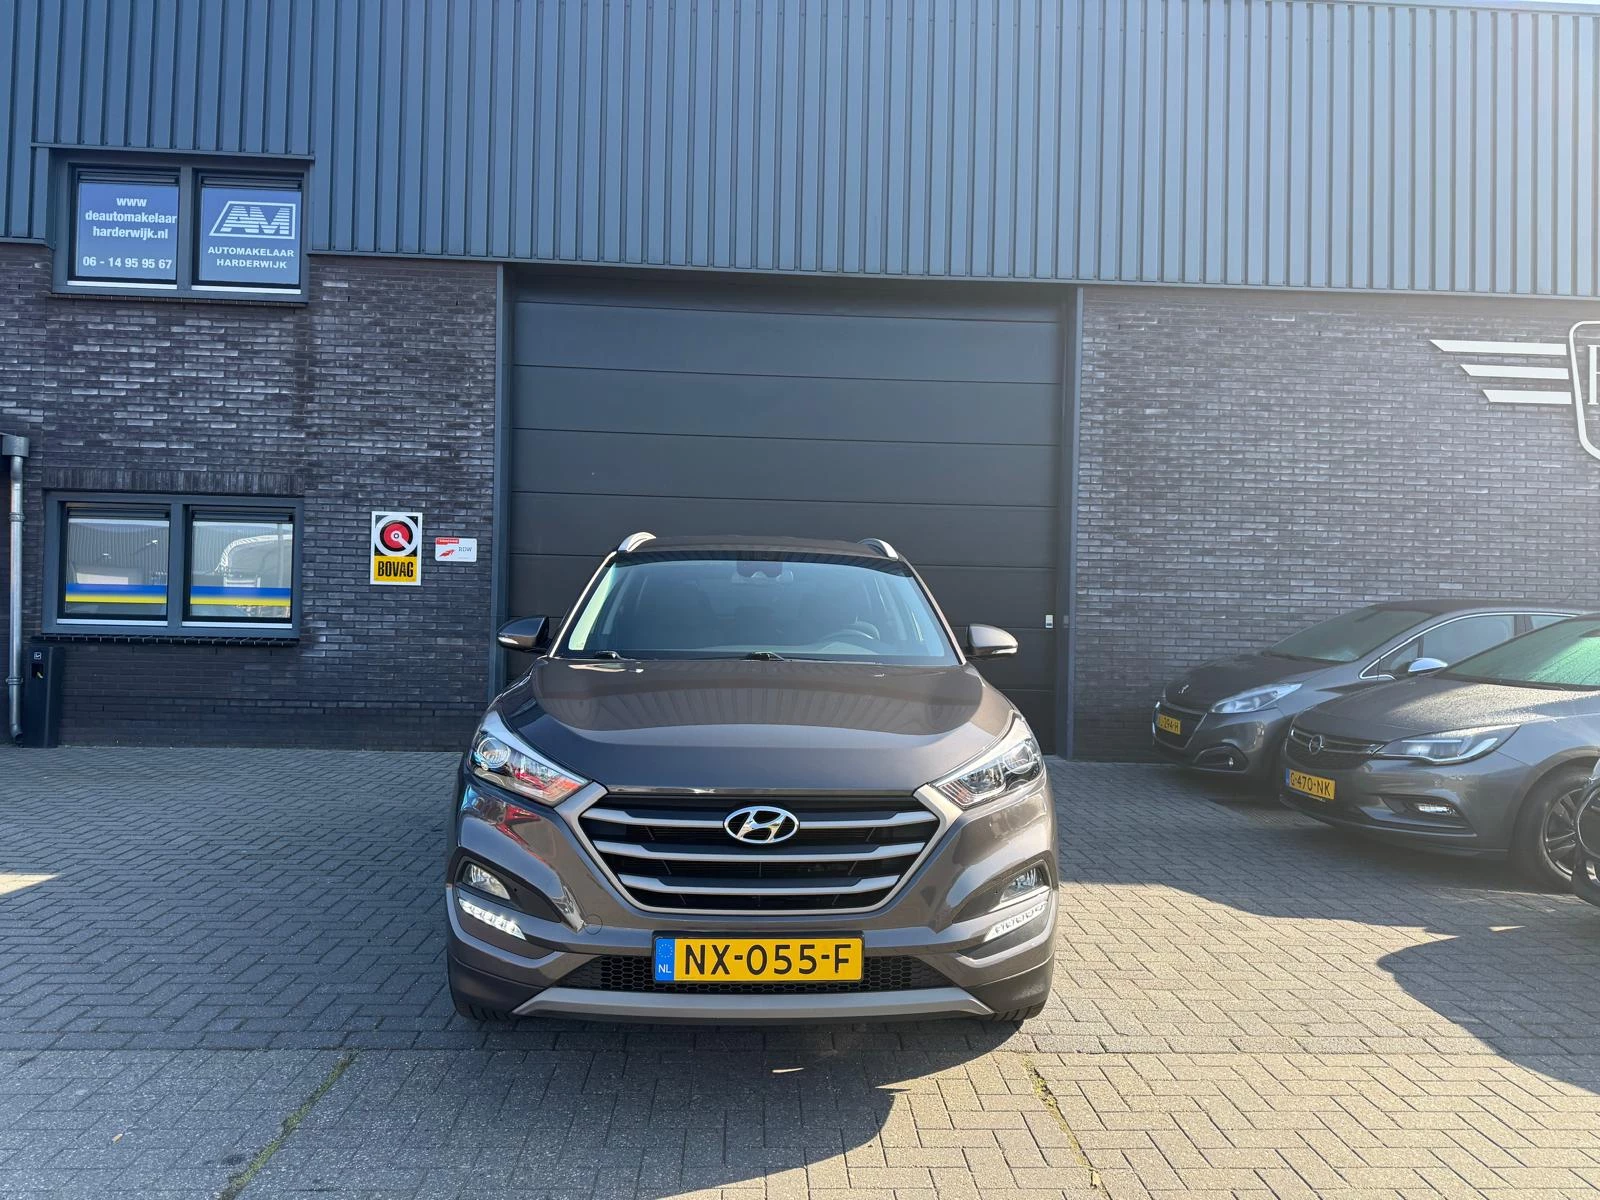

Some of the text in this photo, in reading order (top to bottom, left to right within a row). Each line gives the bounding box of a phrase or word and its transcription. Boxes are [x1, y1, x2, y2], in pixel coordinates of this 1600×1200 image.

[116, 197, 147, 207] www
[85, 210, 178, 224] deautomakelaar
[220, 205, 291, 235] AM
[92, 225, 169, 241] harderwijk.nl
[207, 246, 295, 257] AUTOMAKELAAR
[82, 256, 97, 267] 06
[108, 257, 122, 268] 14
[124, 257, 139, 268] 95
[141, 258, 156, 269] 95
[158, 259, 173, 269] 67
[216, 258, 288, 269] HARDERWIJK
[377, 560, 414, 578] BOVAG
[1290, 771, 1331, 797] G-470-NK
[684, 943, 852, 975] NX-055-F
[657, 964, 672, 974] NL
